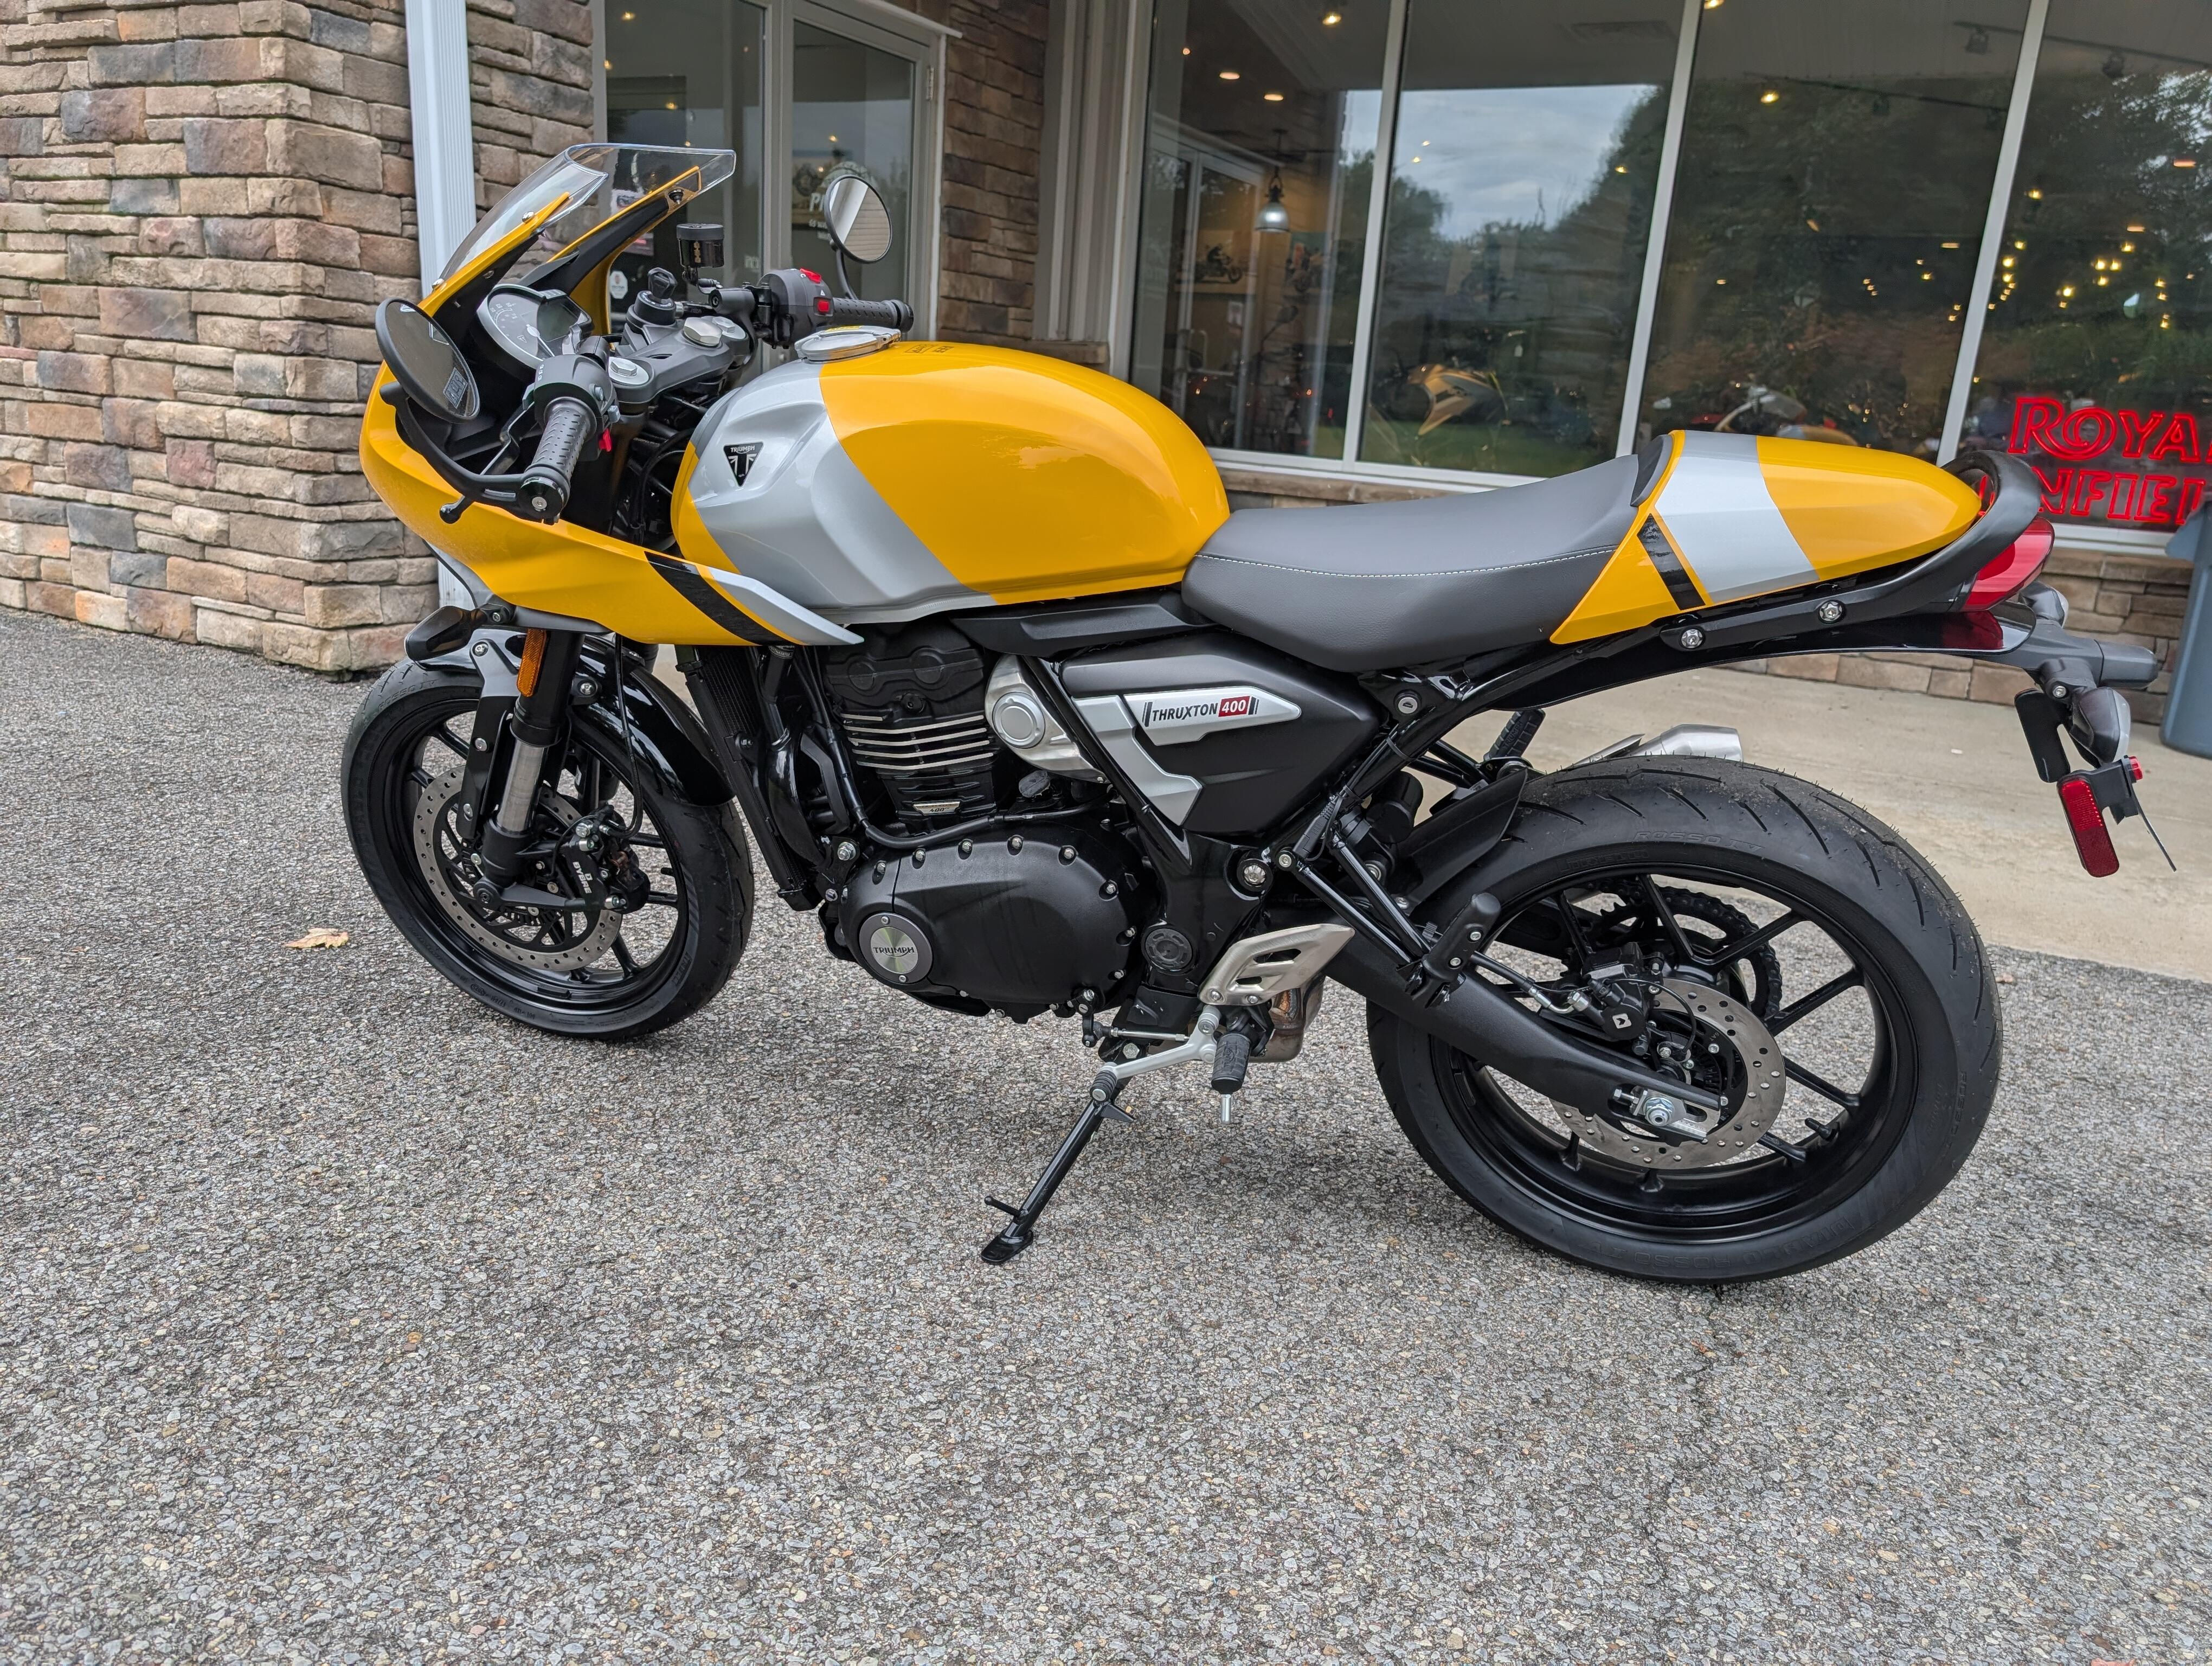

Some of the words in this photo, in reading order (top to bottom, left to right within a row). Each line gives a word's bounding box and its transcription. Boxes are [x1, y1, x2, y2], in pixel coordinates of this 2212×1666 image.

[2008, 396, 2212, 461] ROYA
[730, 445, 755, 454] TRIUMPH
[1152, 703, 1219, 721] THRUXTON
[1221, 699, 1246, 714] 400
[1634, 831, 1722, 844] ROSSO
[572, 861, 593, 894] BYBRE
[873, 947, 915, 957] TRIUMPH
[1635, 1251, 1733, 1268] ROSSO
